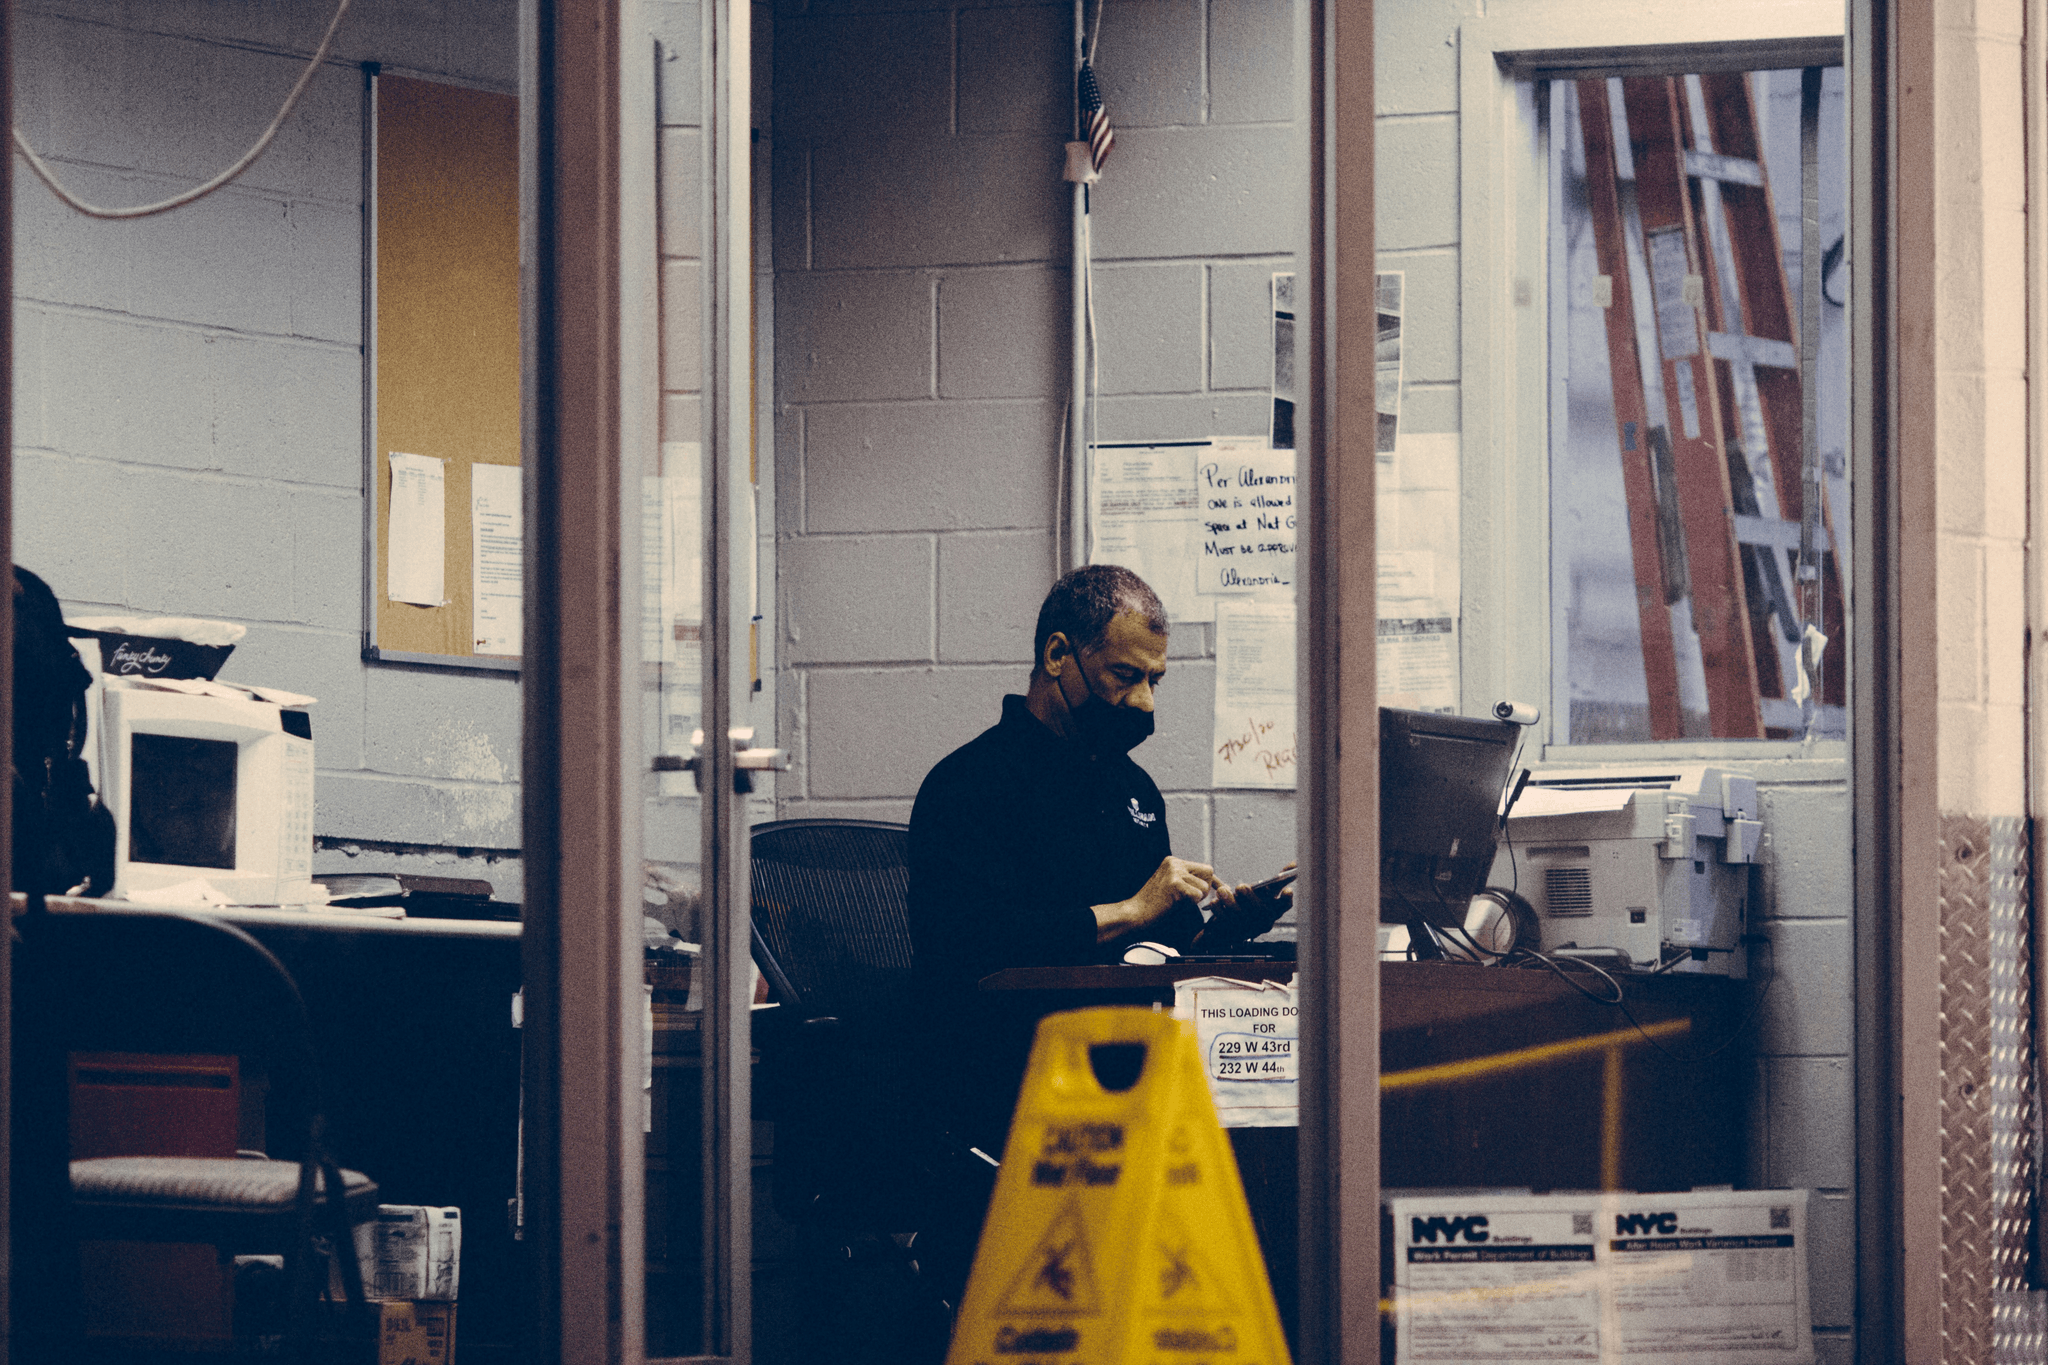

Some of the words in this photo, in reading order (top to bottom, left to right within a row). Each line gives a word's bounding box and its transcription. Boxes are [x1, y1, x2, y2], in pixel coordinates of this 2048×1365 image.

[1200, 463, 1232, 488] Per
[1238, 465, 1297, 488] Alexandri
[1234, 496, 1243, 509] is
[1250, 495, 1292, 509] allowed
[1257, 512, 1282, 531] Nat
[1285, 515, 1298, 530] G
[1201, 1008, 1226, 1019] THIS
[1229, 1007, 1279, 1018] LOADING
[1282, 1006, 1299, 1017] DO
[1253, 1024, 1276, 1034] FOR
[1218, 1042, 1241, 1054] 229
[1245, 1041, 1258, 1053] W
[1262, 1041, 1291, 1053] 43rd
[1219, 1062, 1242, 1074] 232
[1245, 1062, 1259, 1073] W
[1262, 1061, 1285, 1073] 44th
[1411, 1216, 1490, 1243] NYC
[1615, 1212, 1678, 1235] NYC
[1412, 1251, 1441, 1261] Work
[1443, 1250, 1478, 1261] Permit
